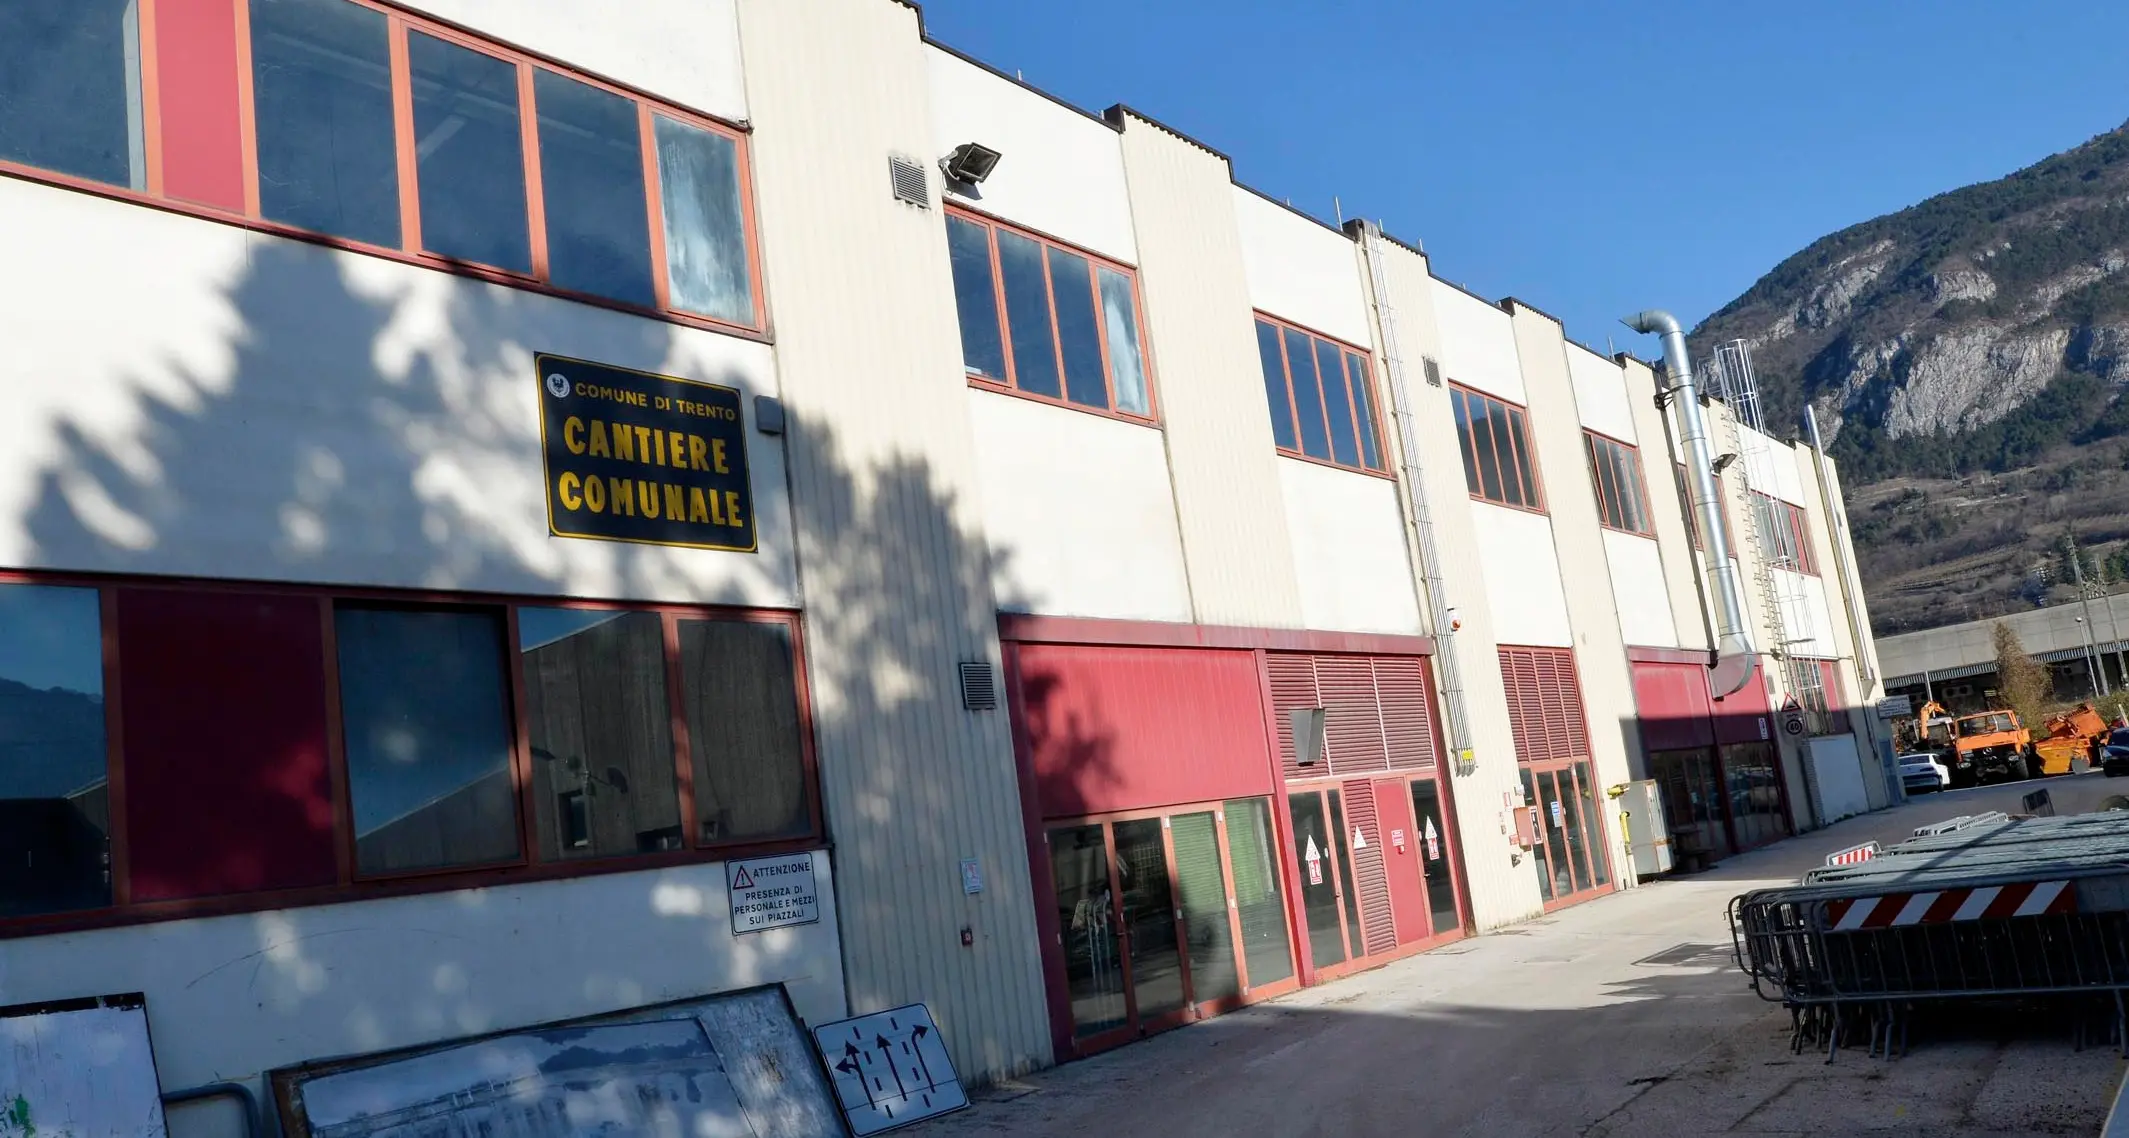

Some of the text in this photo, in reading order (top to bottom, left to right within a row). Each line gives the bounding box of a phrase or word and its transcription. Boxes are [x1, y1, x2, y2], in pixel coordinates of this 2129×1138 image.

[575, 382, 735, 421] COMUNE DI TRENTO
[564, 416, 729, 474] CANTIERE
[559, 472, 743, 527] COMUNALE
[753, 862, 811, 878] ATTENZIONE
[745, 885, 803, 901] PRESENZA DI
[734, 900, 784, 915] PERSONALE
[791, 896, 815, 906] MEZZI
[749, 909, 804, 925] SUI PIAZZALI
